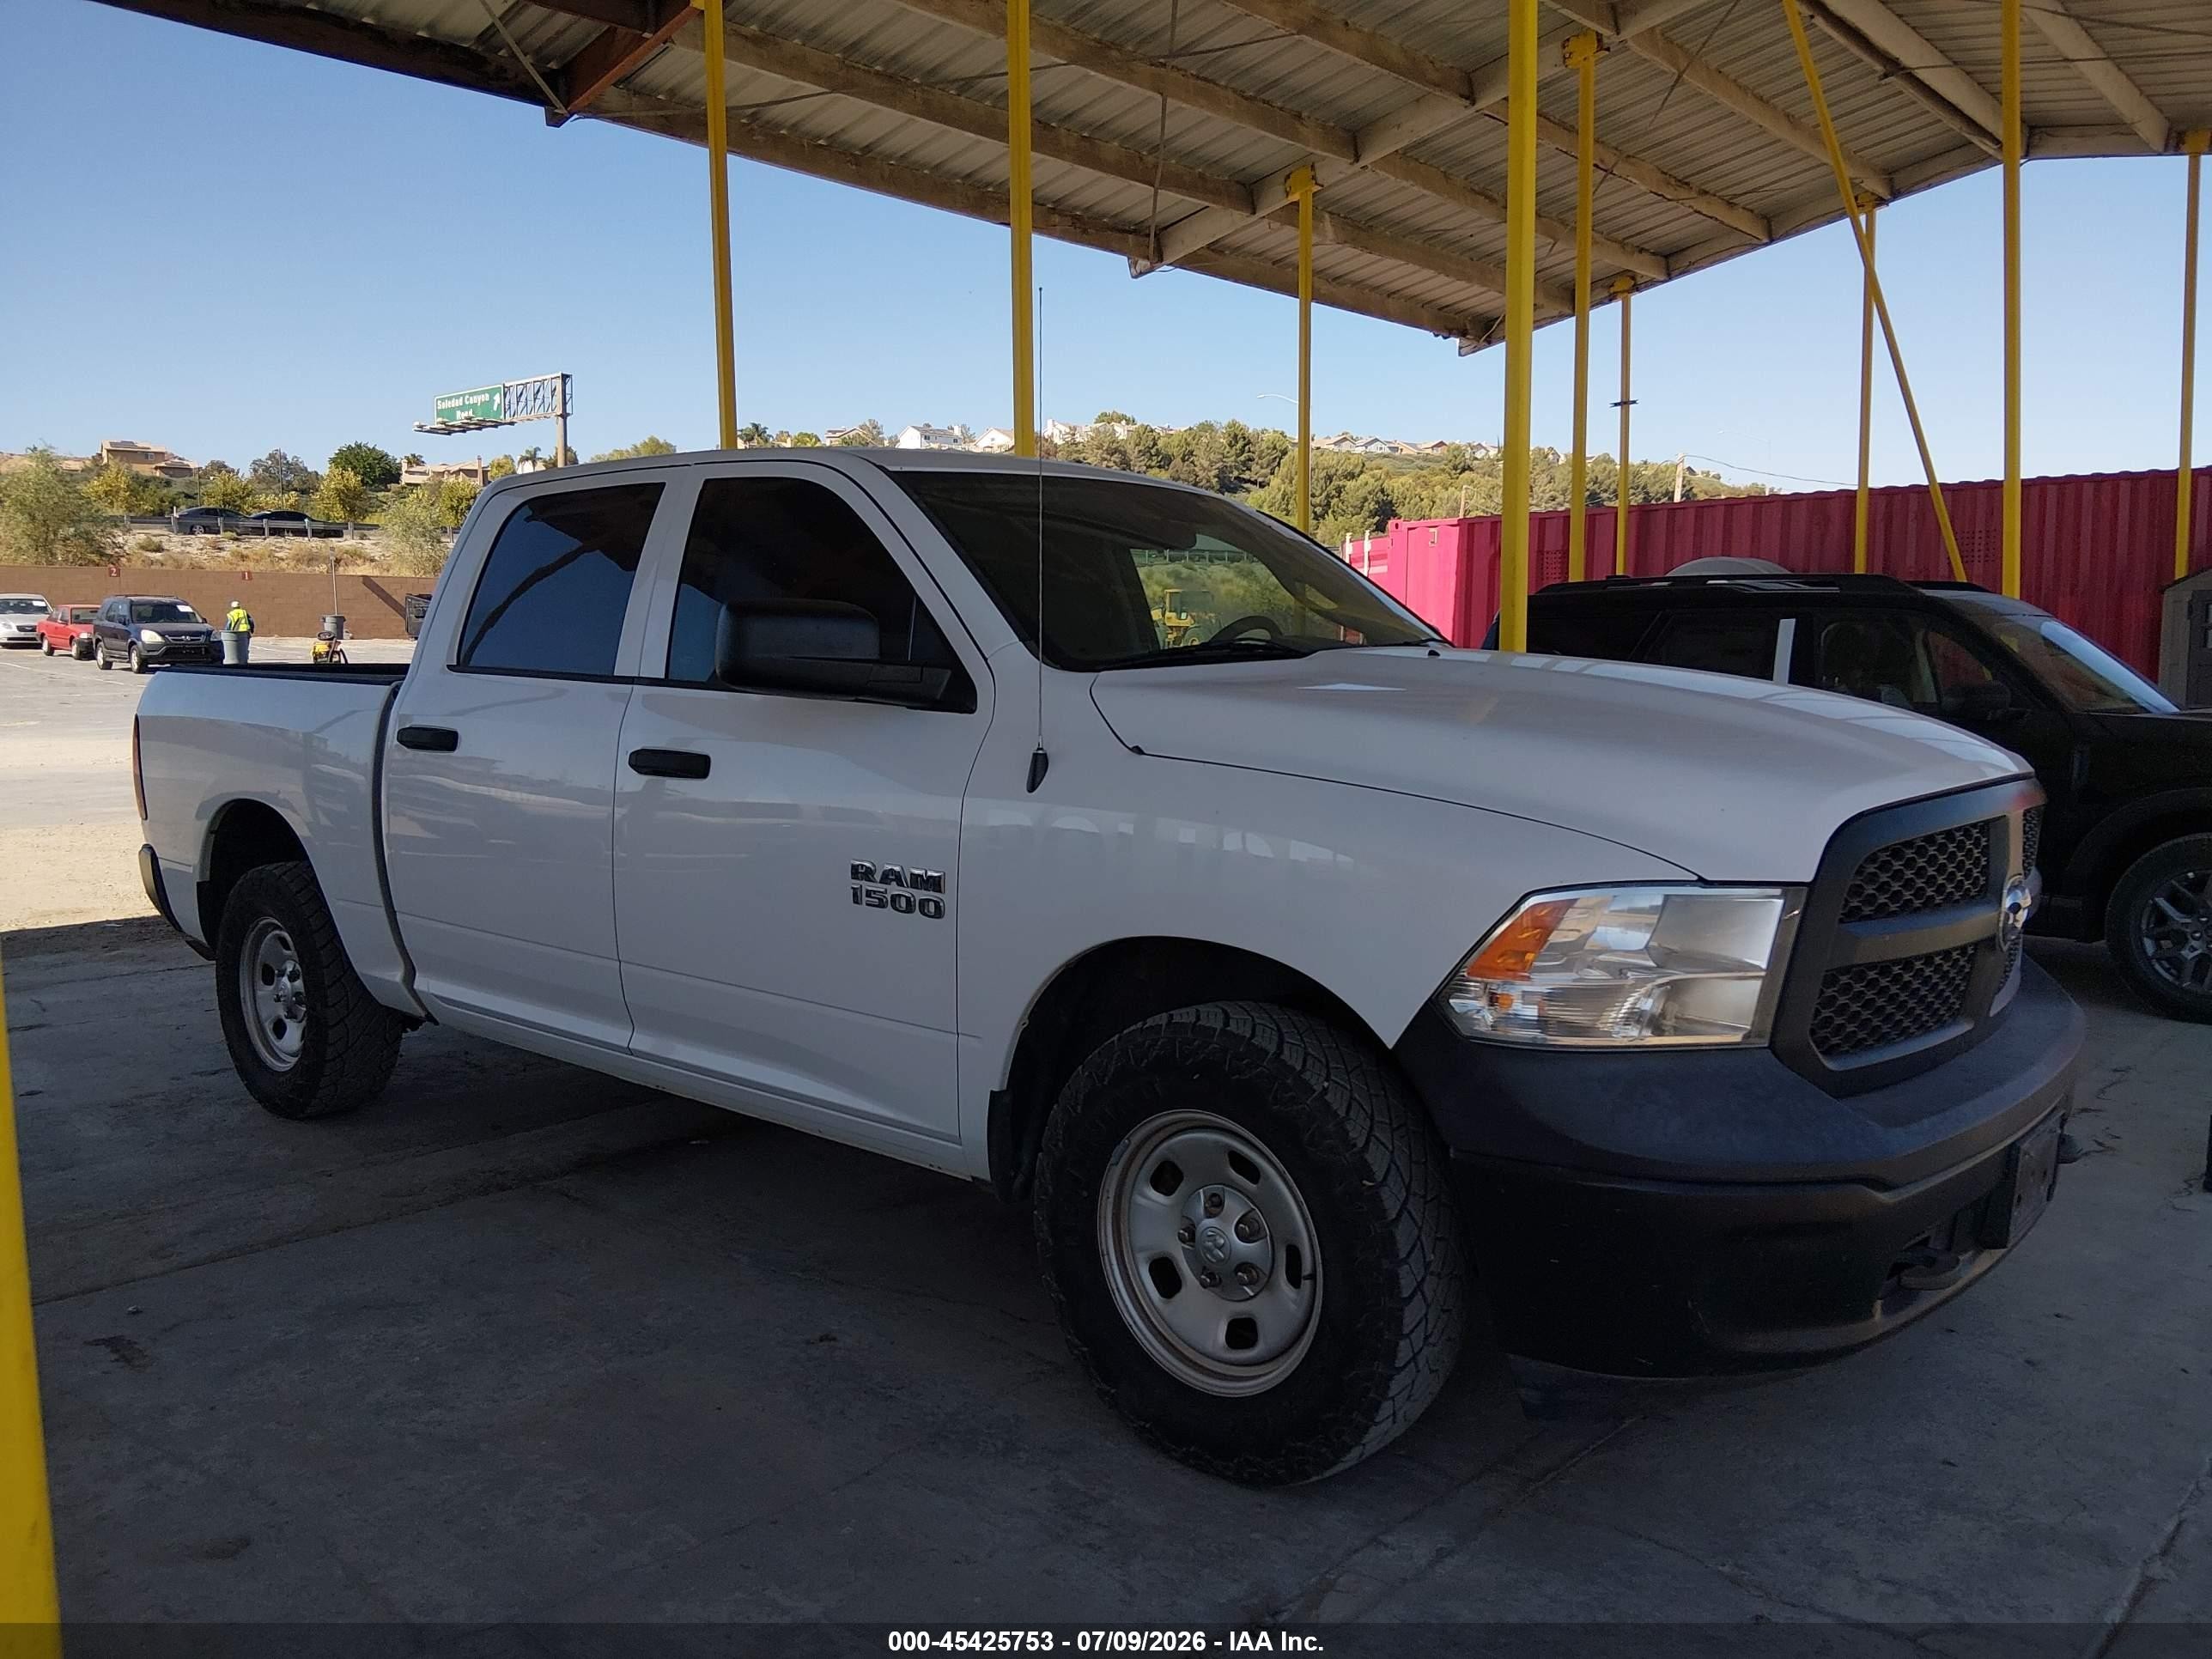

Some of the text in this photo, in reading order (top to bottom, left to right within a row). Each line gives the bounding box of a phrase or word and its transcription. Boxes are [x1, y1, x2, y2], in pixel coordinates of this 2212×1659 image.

[437, 392, 490, 410] Soledad Canyon
[111, 568, 118, 576] 2
[851, 860, 945, 893] RAM
[851, 884, 945, 920] 1500
